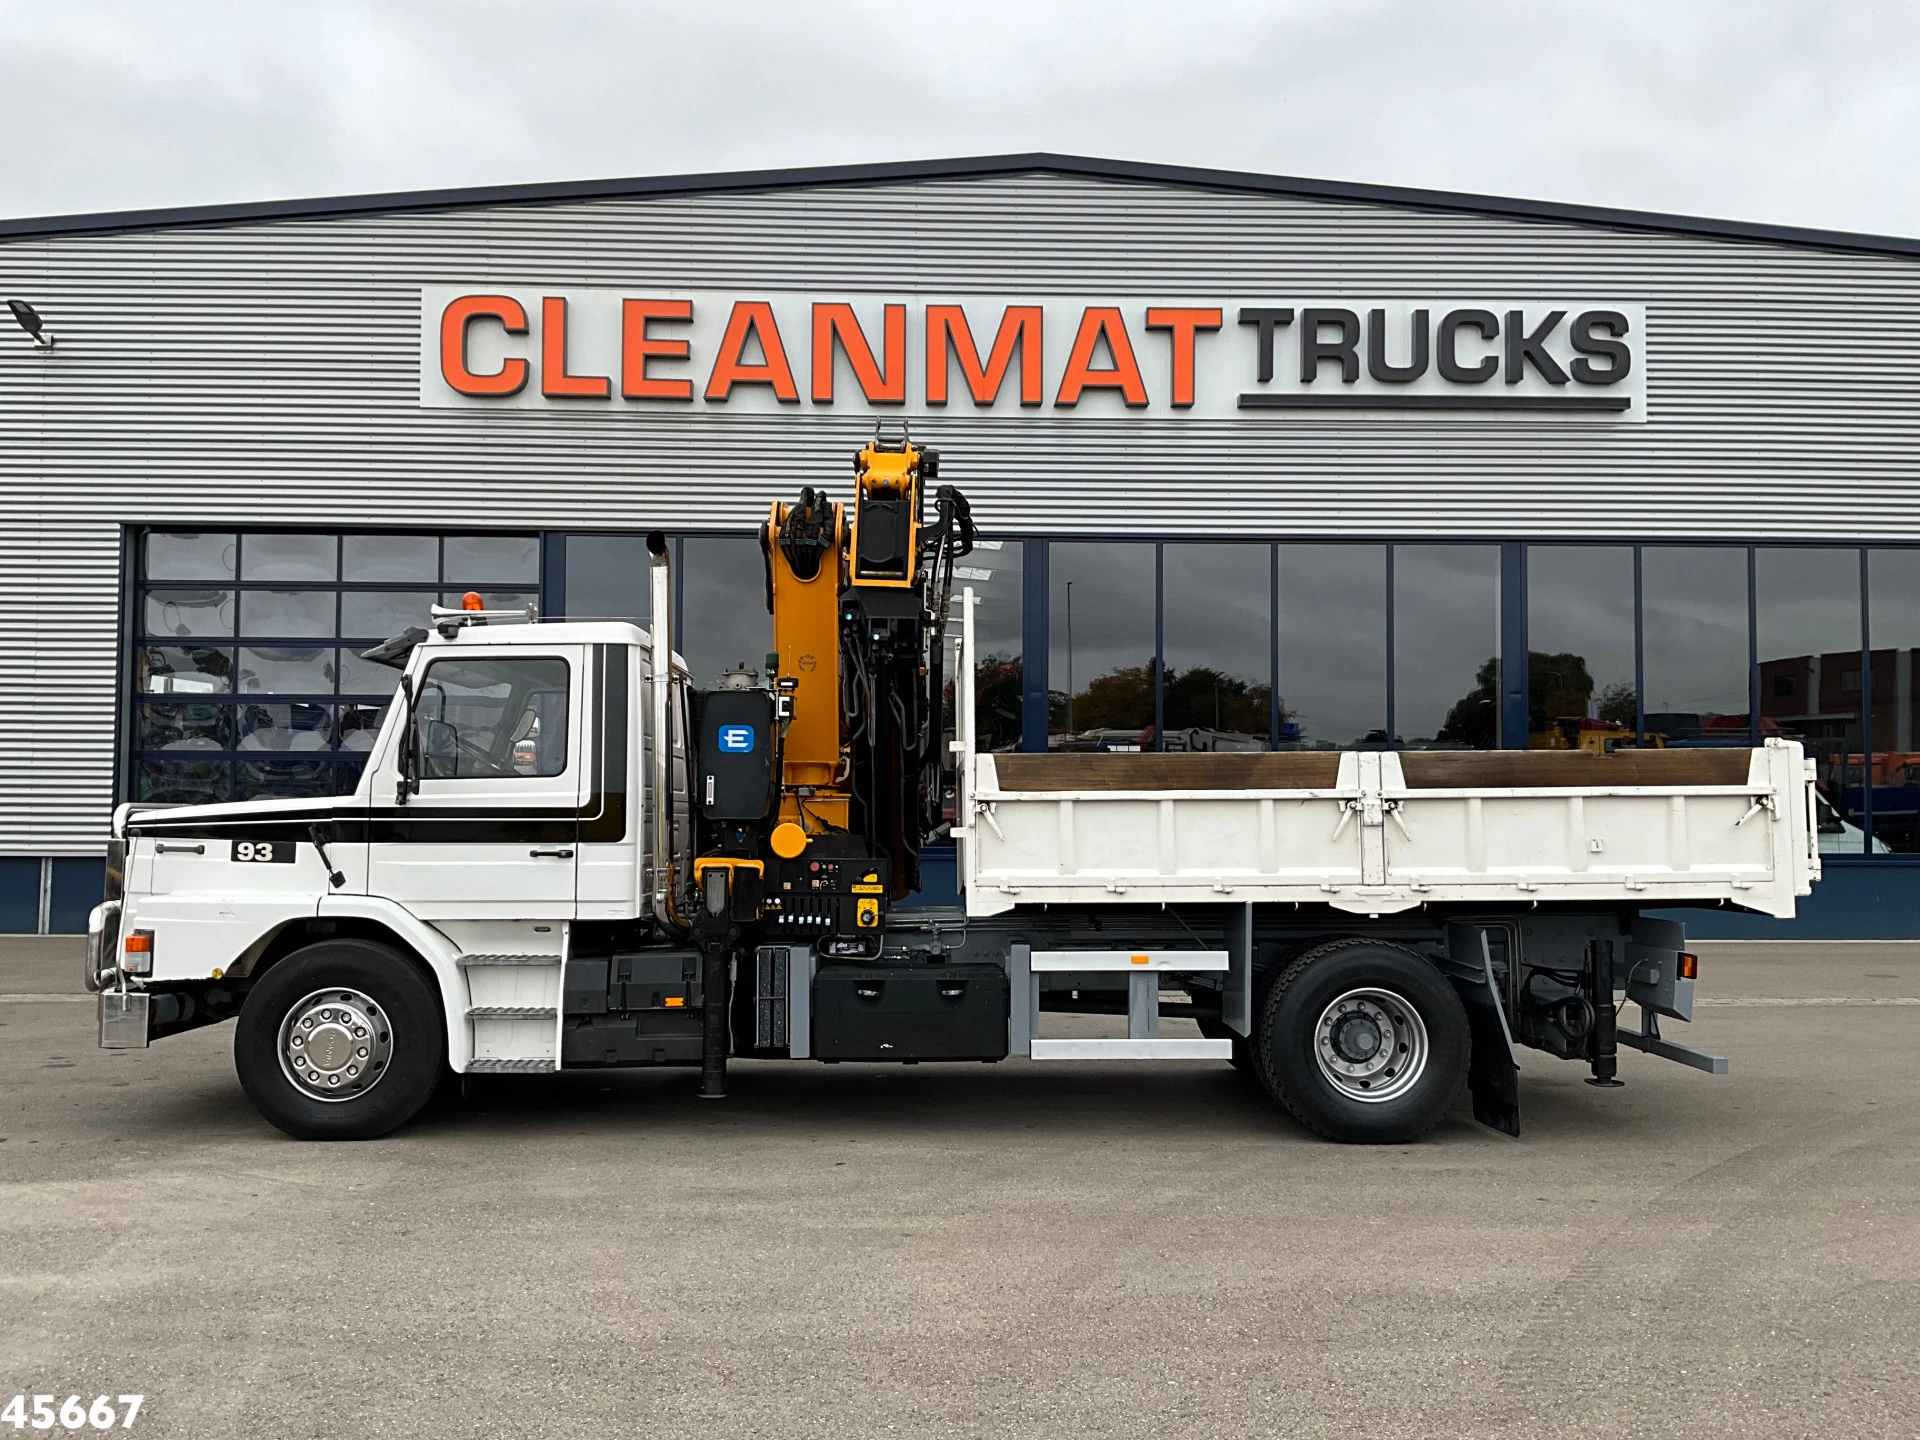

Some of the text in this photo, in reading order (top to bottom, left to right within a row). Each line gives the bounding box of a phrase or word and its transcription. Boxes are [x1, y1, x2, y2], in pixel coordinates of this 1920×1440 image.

[440, 295, 1632, 408] CLEANMAT TRUCKS
[237, 842, 273, 861] 93
